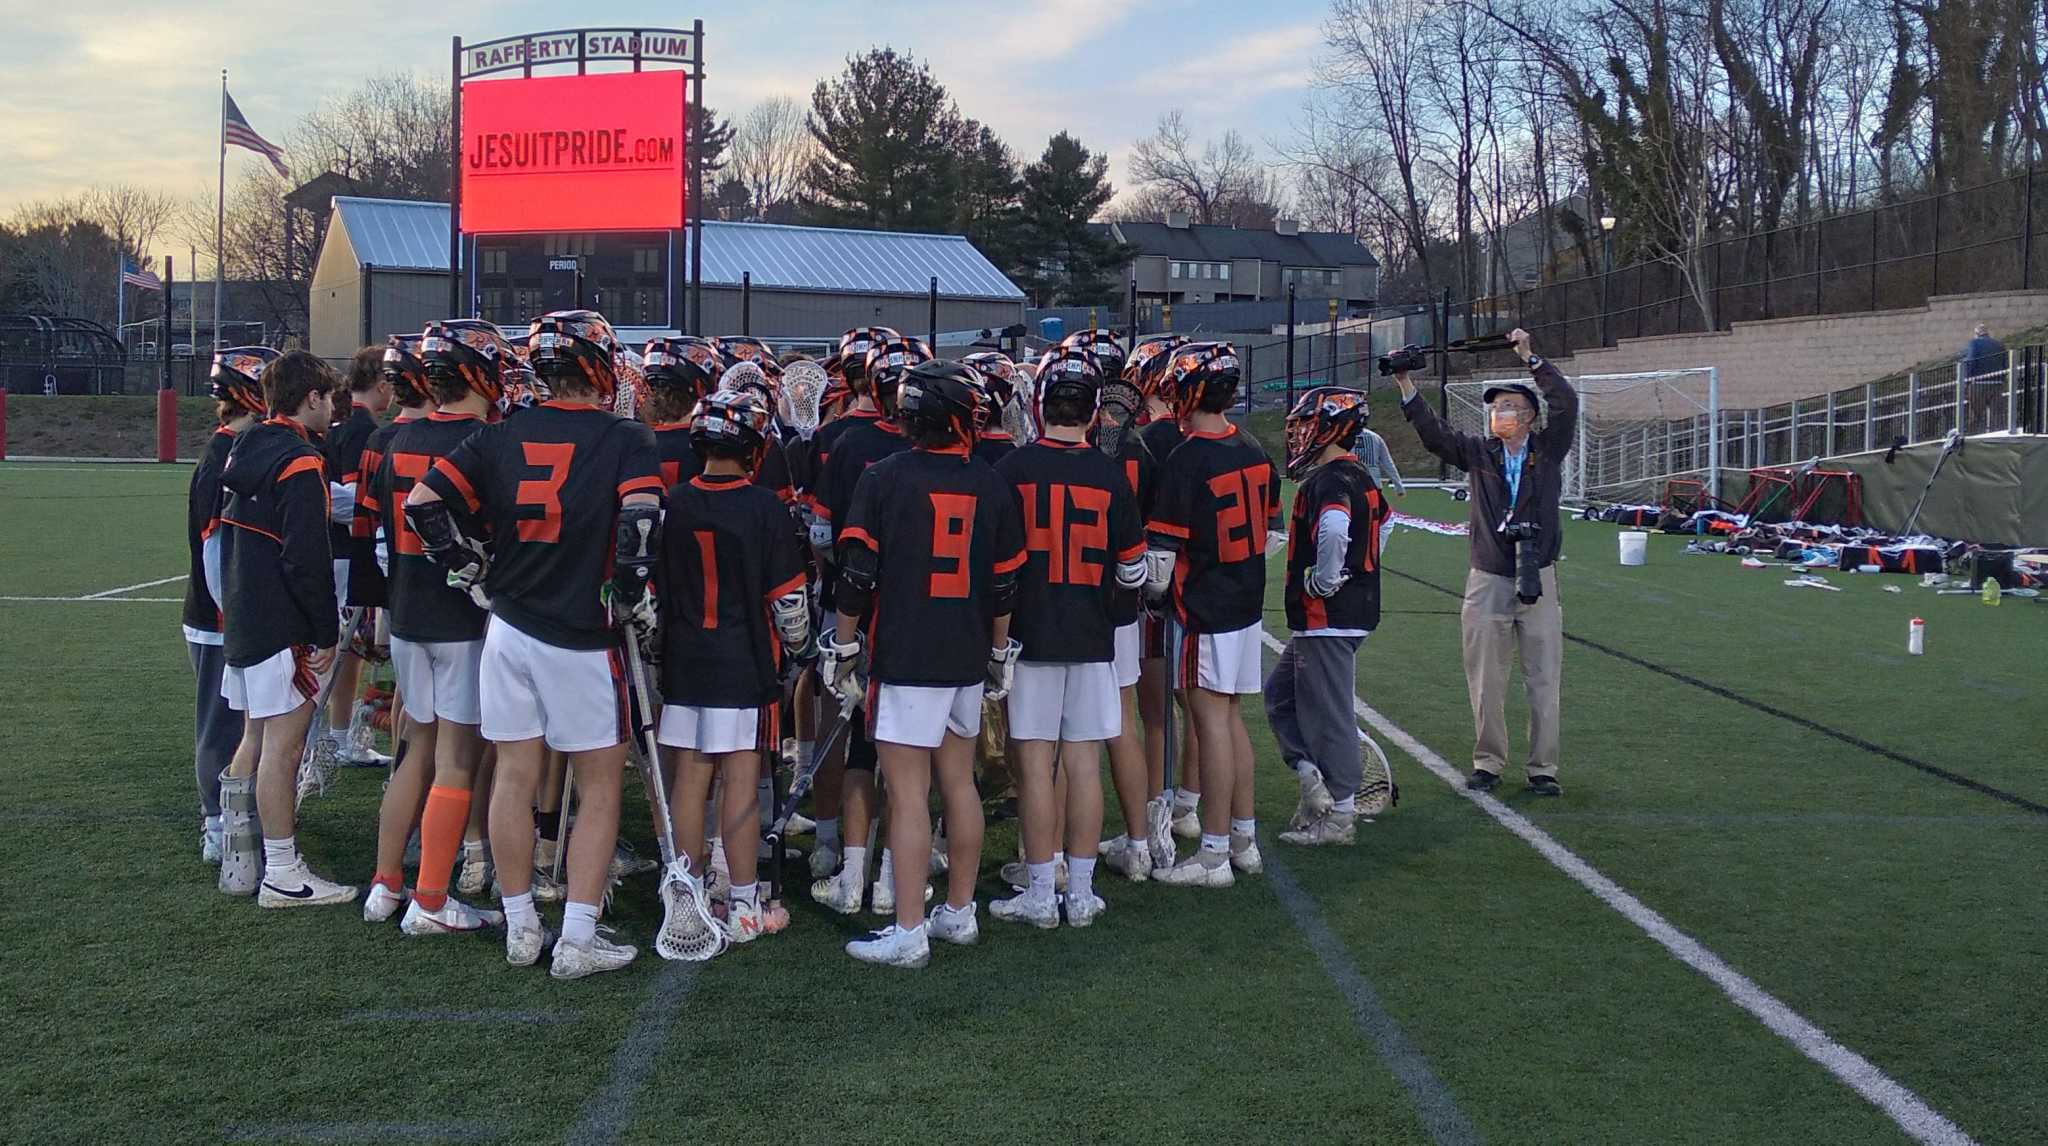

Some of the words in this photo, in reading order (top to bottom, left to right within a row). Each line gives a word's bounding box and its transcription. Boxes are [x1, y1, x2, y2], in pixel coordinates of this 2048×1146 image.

[474, 37, 577, 69] RAFFERTY
[588, 36, 689, 57] STADIUM
[470, 129, 674, 169] JESUITPRIDE.COM
[549, 259, 578, 271] PERIOD
[515, 441, 577, 544] 3
[1015, 483, 1112, 587] 42
[1205, 463, 1271, 563] 20
[692, 530, 719, 630] 1
[928, 492, 978, 599] 9
